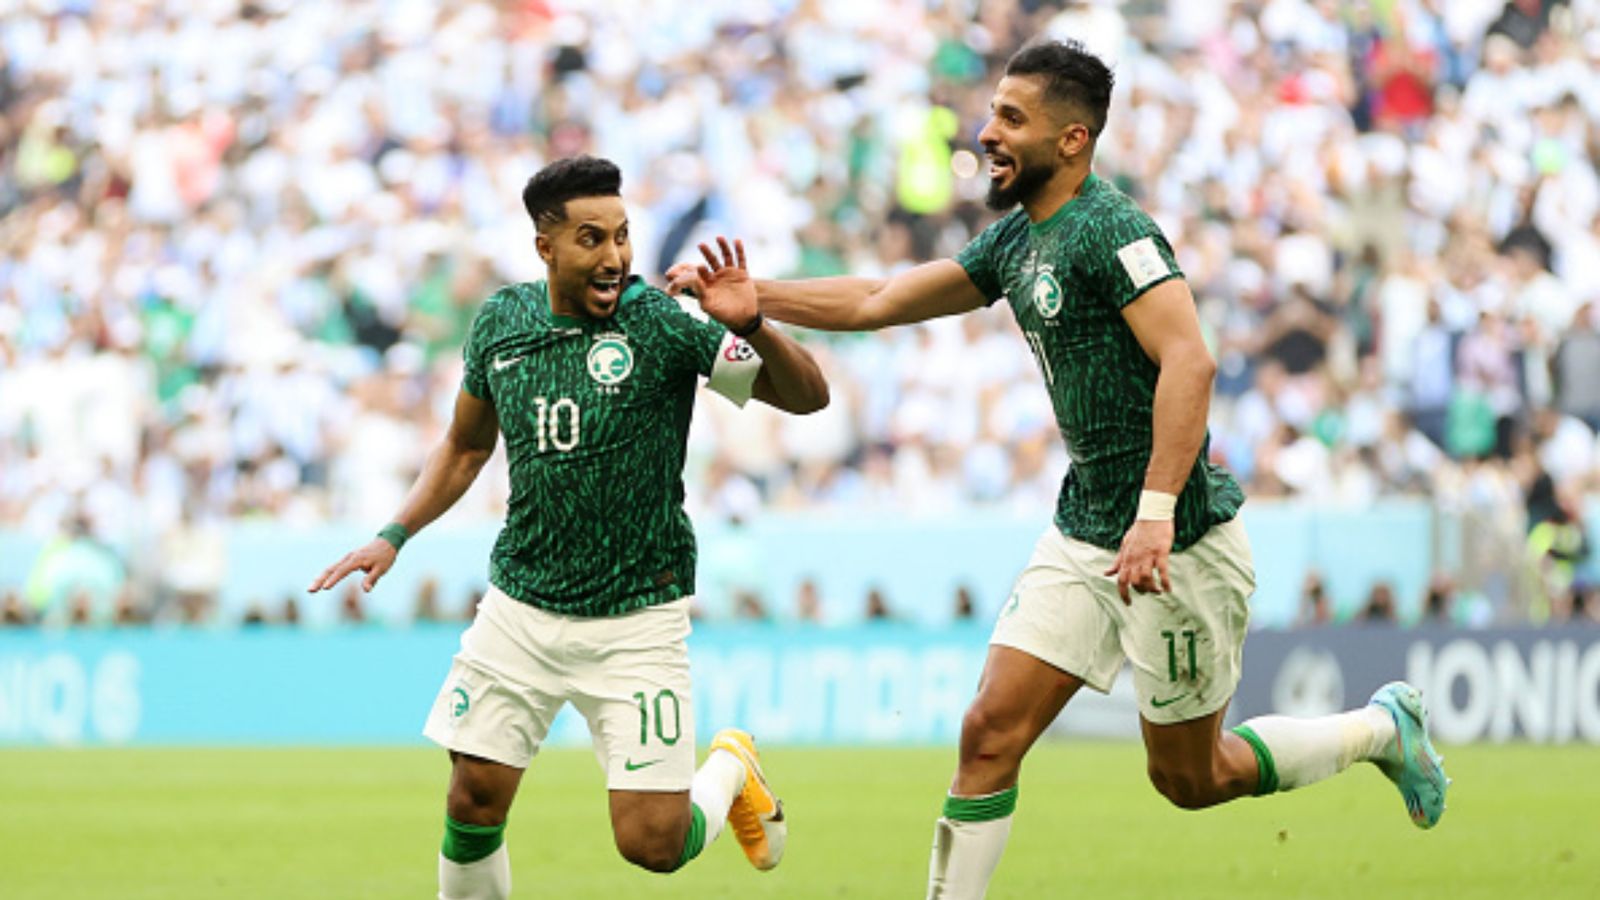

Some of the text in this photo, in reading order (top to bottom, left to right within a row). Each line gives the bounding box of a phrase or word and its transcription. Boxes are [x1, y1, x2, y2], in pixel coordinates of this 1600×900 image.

[533, 396, 580, 453] 10
[1161, 630, 1197, 682] 11
[633, 688, 681, 746] 10
